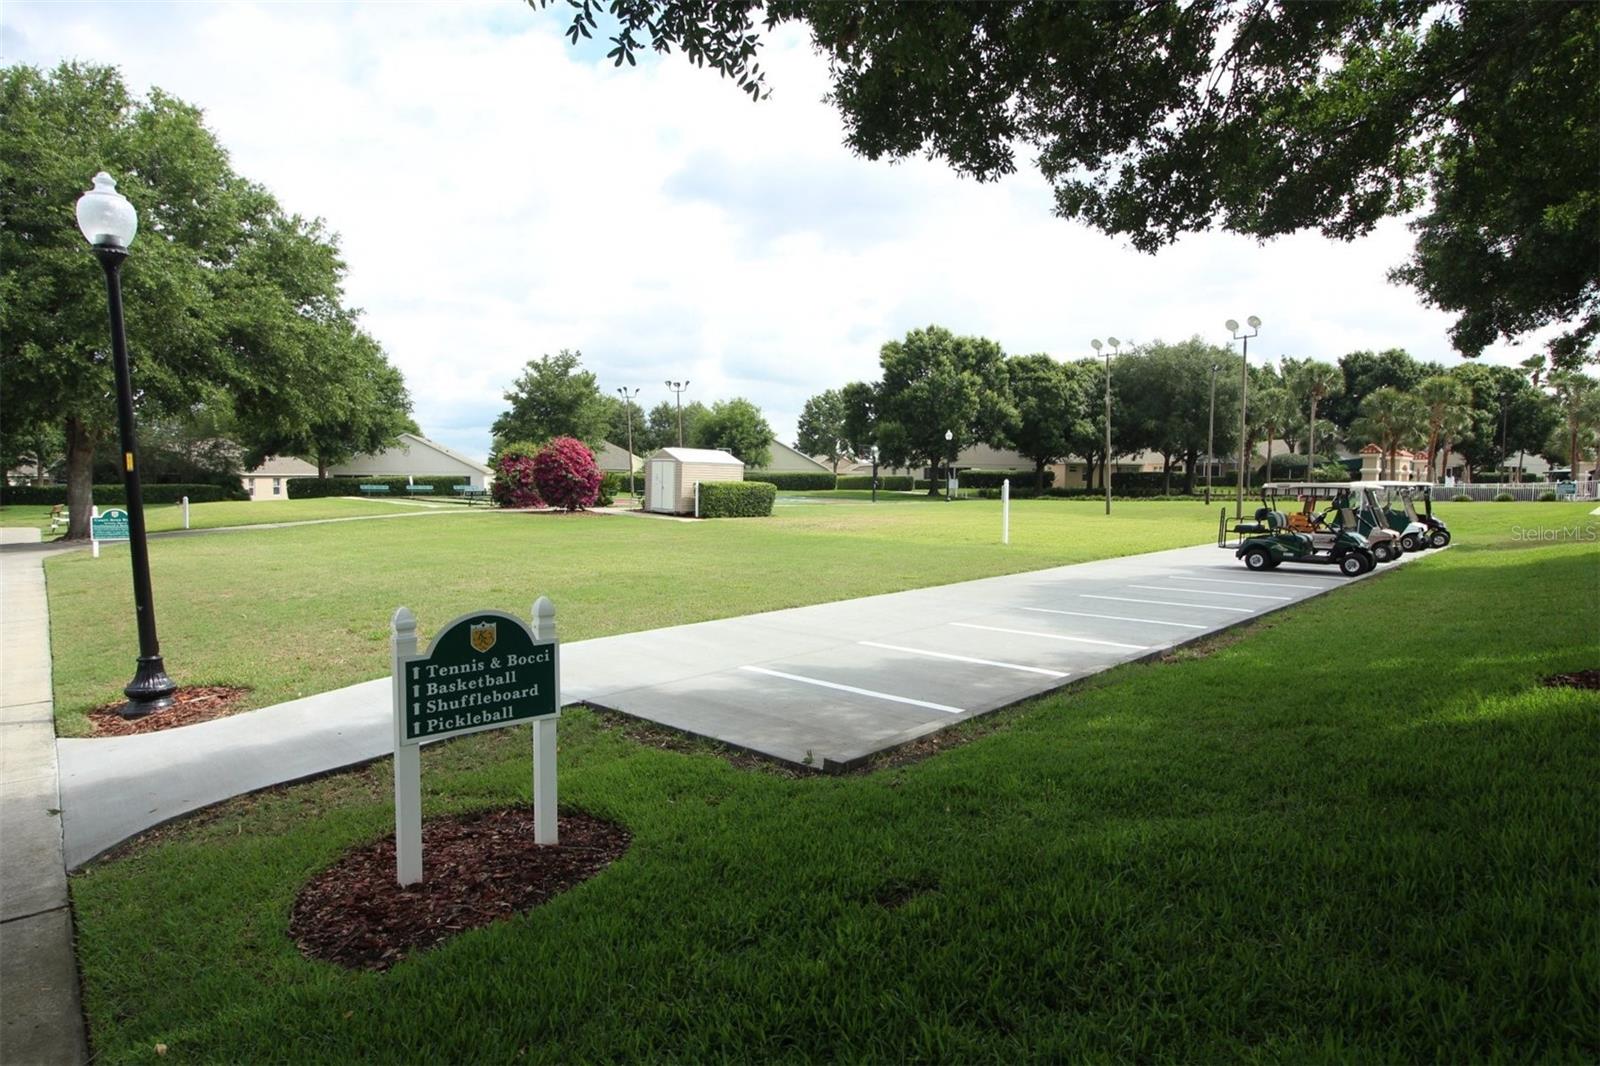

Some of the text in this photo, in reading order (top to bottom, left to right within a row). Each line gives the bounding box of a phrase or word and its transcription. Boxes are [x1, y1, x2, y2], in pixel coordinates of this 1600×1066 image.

[426, 649, 550, 678] Tennis & Bocci
[426, 671, 517, 696] Basketball
[426, 684, 539, 714] Shuffleboard
[427, 706, 514, 733] Pickleball
